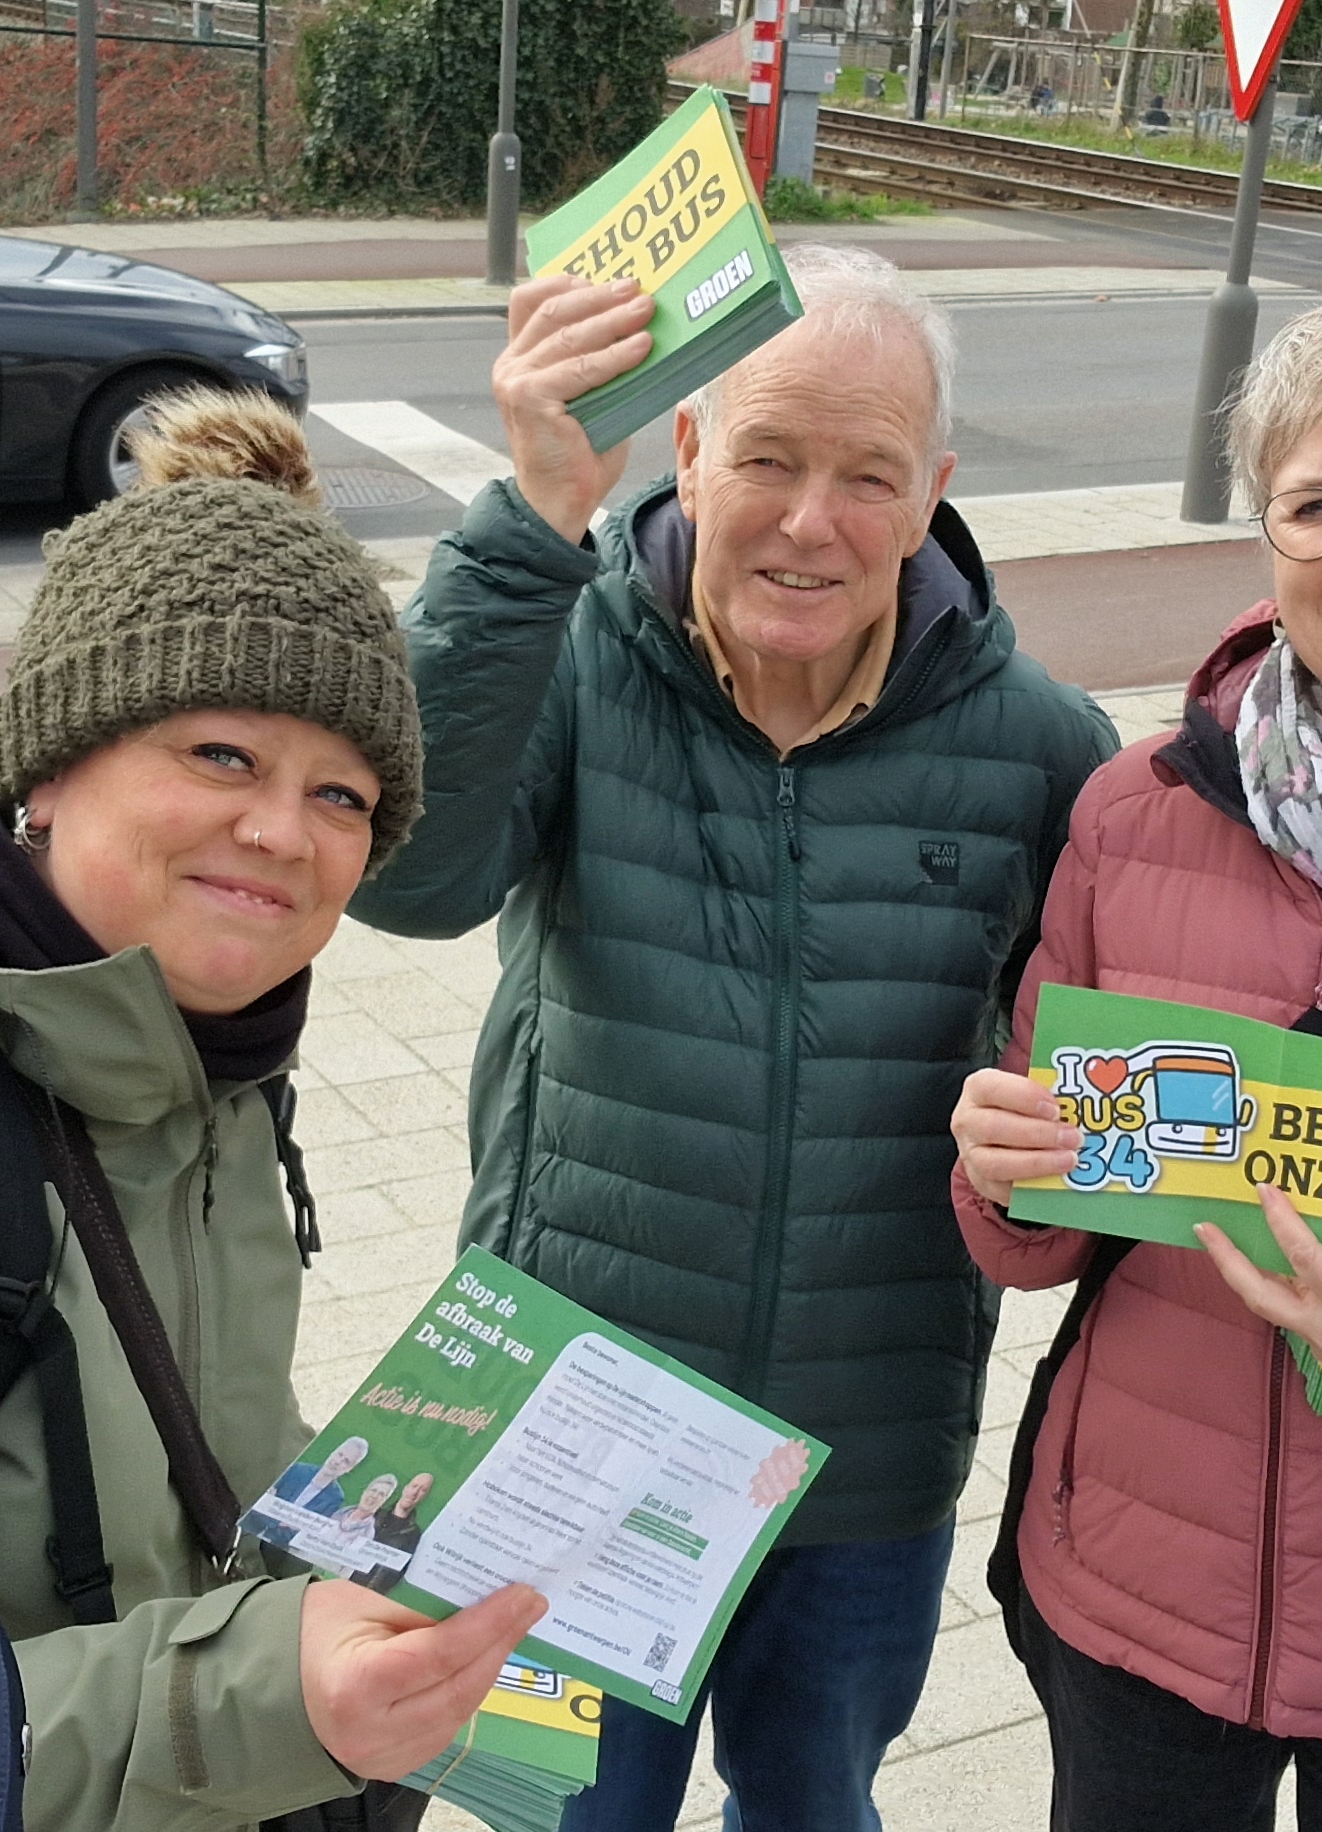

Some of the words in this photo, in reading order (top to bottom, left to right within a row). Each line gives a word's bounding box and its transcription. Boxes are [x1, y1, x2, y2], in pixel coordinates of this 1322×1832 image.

[563, 149, 702, 283] EHOUD
[646, 174, 726, 273] BUS
[686, 251, 754, 320] GROEN
[921, 843, 957, 857] SPRAY
[931, 855, 957, 867] WAY
[1058, 1054, 1083, 1095] I
[1056, 1094, 1145, 1133] BUS
[1068, 1133, 1155, 1188] 34
[455, 1272, 497, 1309] Stop
[494, 1294, 518, 1318] de
[414, 1322, 443, 1349] De
[439, 1336, 477, 1368] Lijn
[435, 1301, 505, 1347] afbraak
[502, 1337, 535, 1365] van
[360, 1382, 404, 1411] Actie
[401, 1390, 423, 1416] is
[441, 1406, 499, 1437] nodig!
[640, 1492, 667, 1511] Kom
[661, 1500, 674, 1514] in
[669, 1507, 694, 1525] actie
[652, 1680, 682, 1704] GROEN
